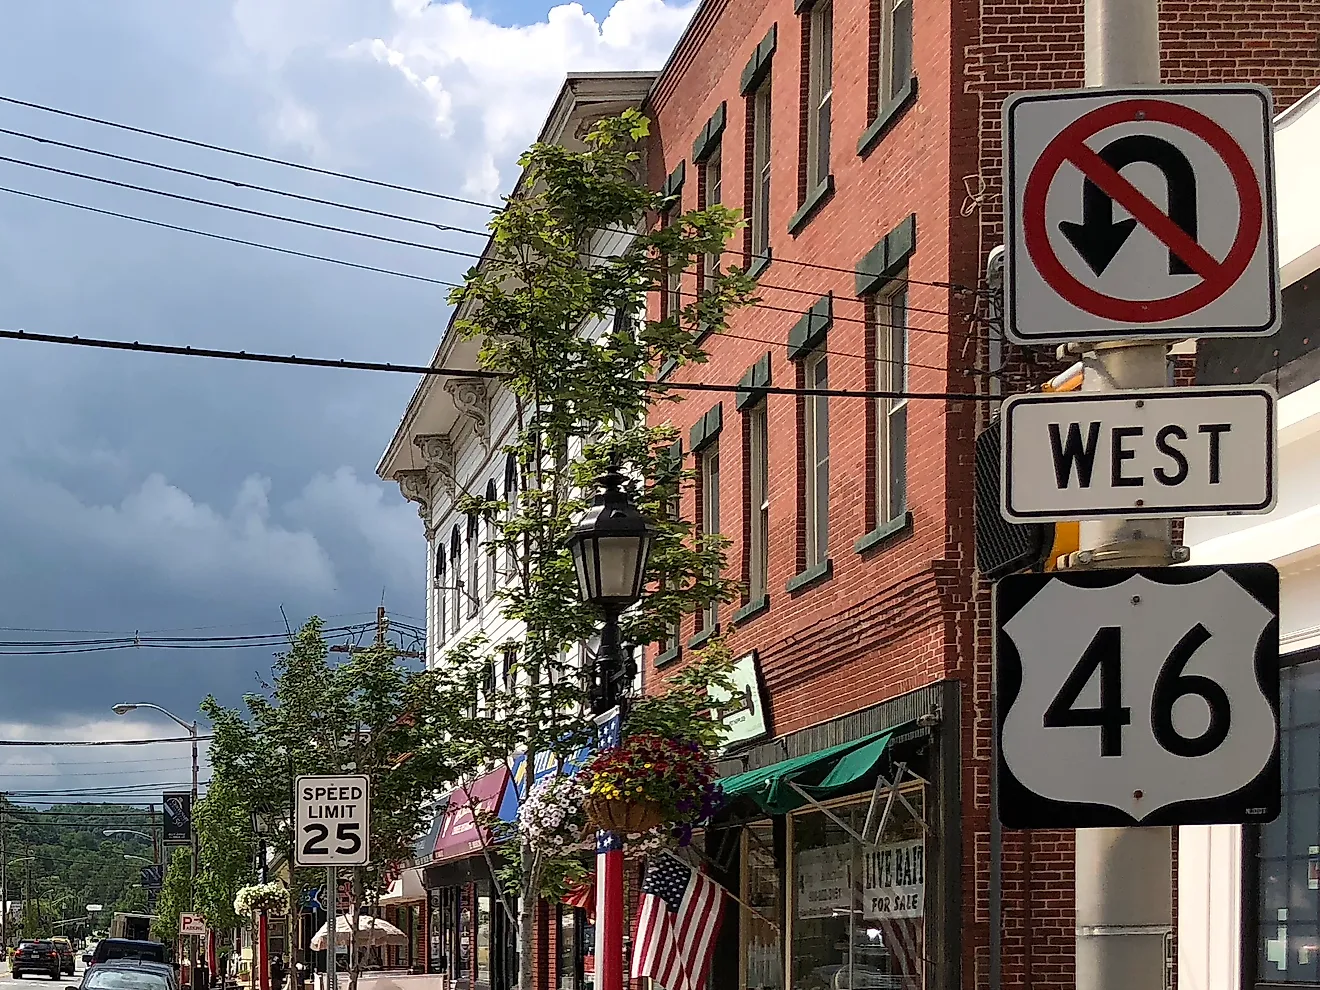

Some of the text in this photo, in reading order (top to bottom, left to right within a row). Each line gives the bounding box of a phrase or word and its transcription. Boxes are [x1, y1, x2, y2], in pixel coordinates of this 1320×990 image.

[1048, 421, 1231, 489] WEST
[1043, 622, 1231, 757] 46
[302, 787, 362, 800] SPEED
[308, 805, 356, 818] LIMIT
[302, 823, 361, 854] 25
[866, 850, 892, 889] LIVE
[895, 845, 923, 886] BAIT
[871, 894, 919, 912] FOR SALE
